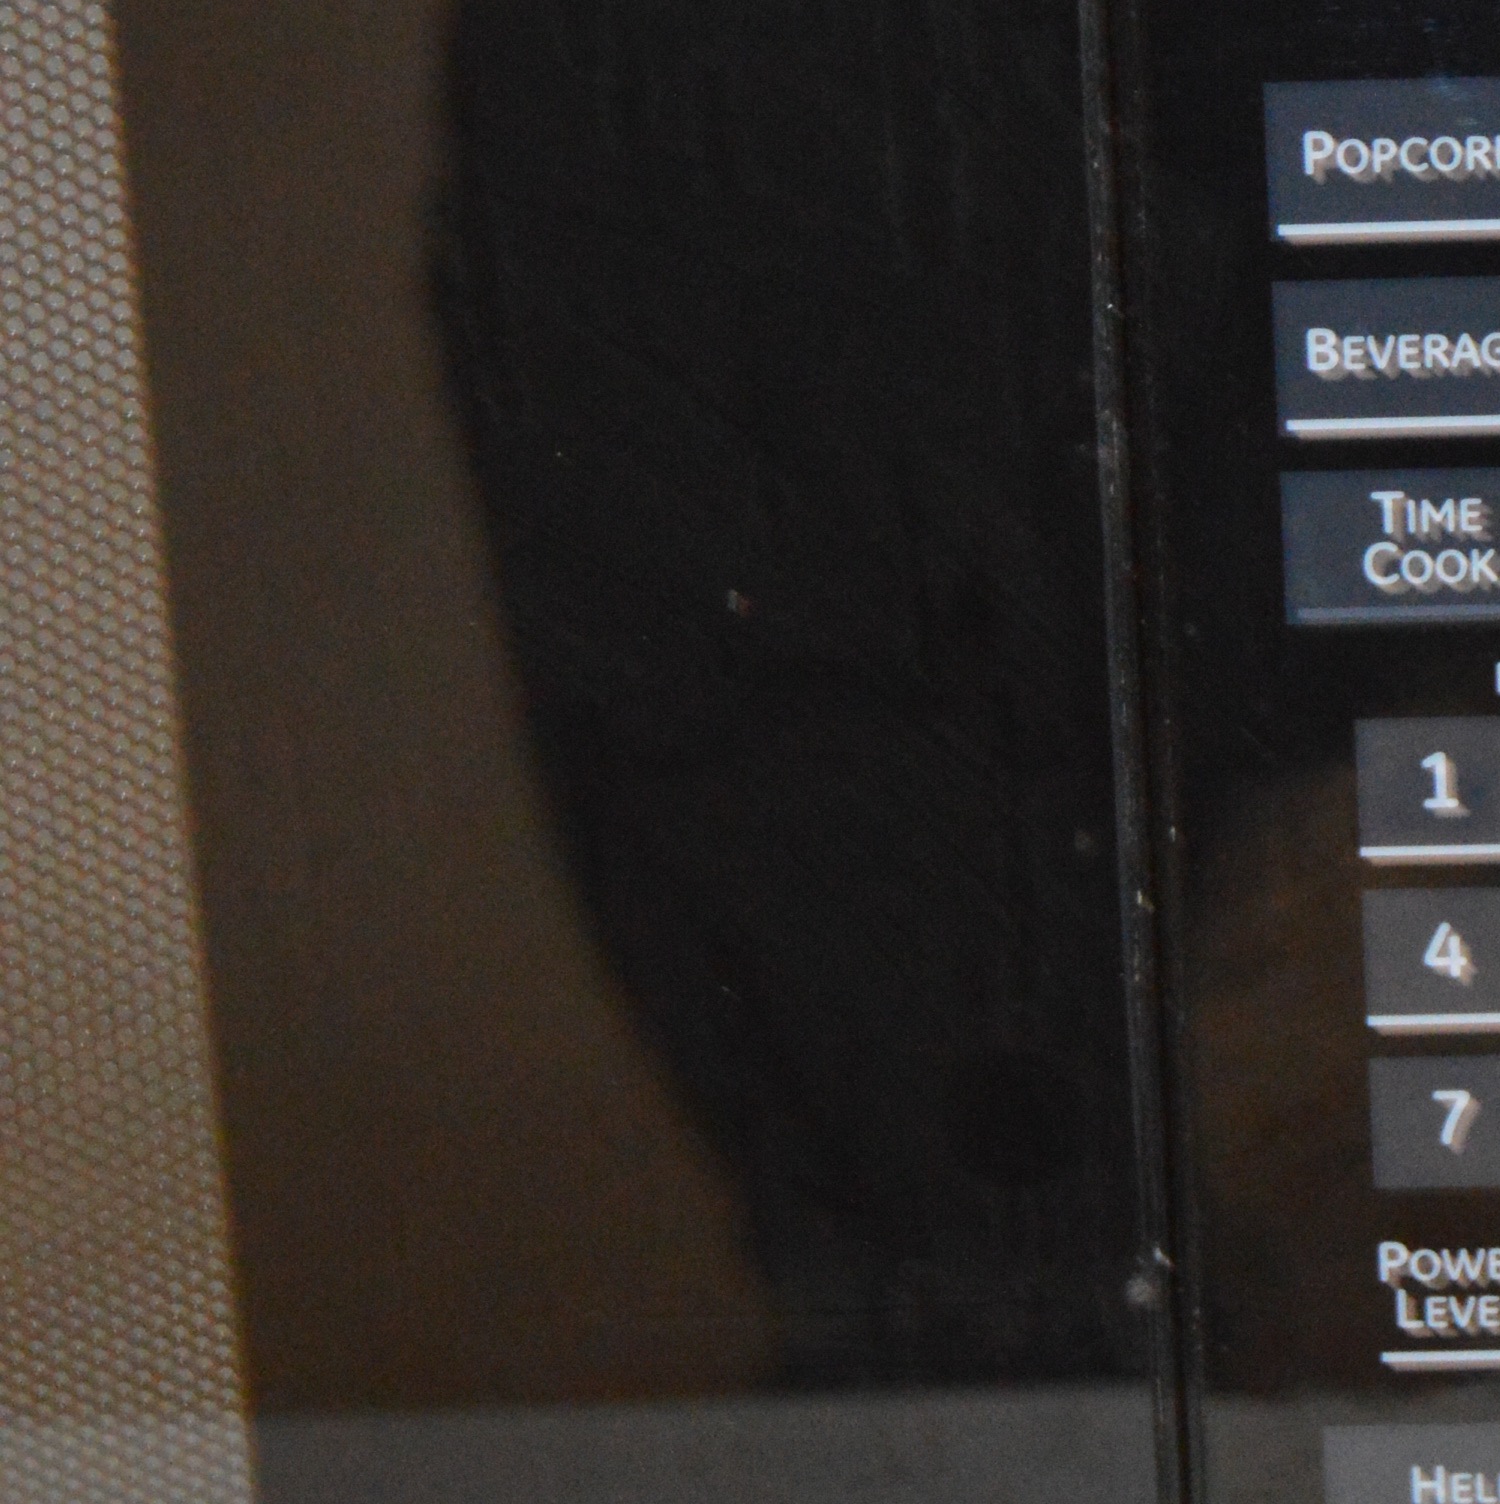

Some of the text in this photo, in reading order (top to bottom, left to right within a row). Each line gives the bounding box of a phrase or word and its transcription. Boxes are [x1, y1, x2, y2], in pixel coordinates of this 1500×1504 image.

[1370, 490, 1482, 534] TIME
[1362, 541, 1498, 588] COOK
[1421, 752, 1459, 811] 1
[1423, 923, 1468, 978] 4
[1432, 1090, 1470, 1146] 7
